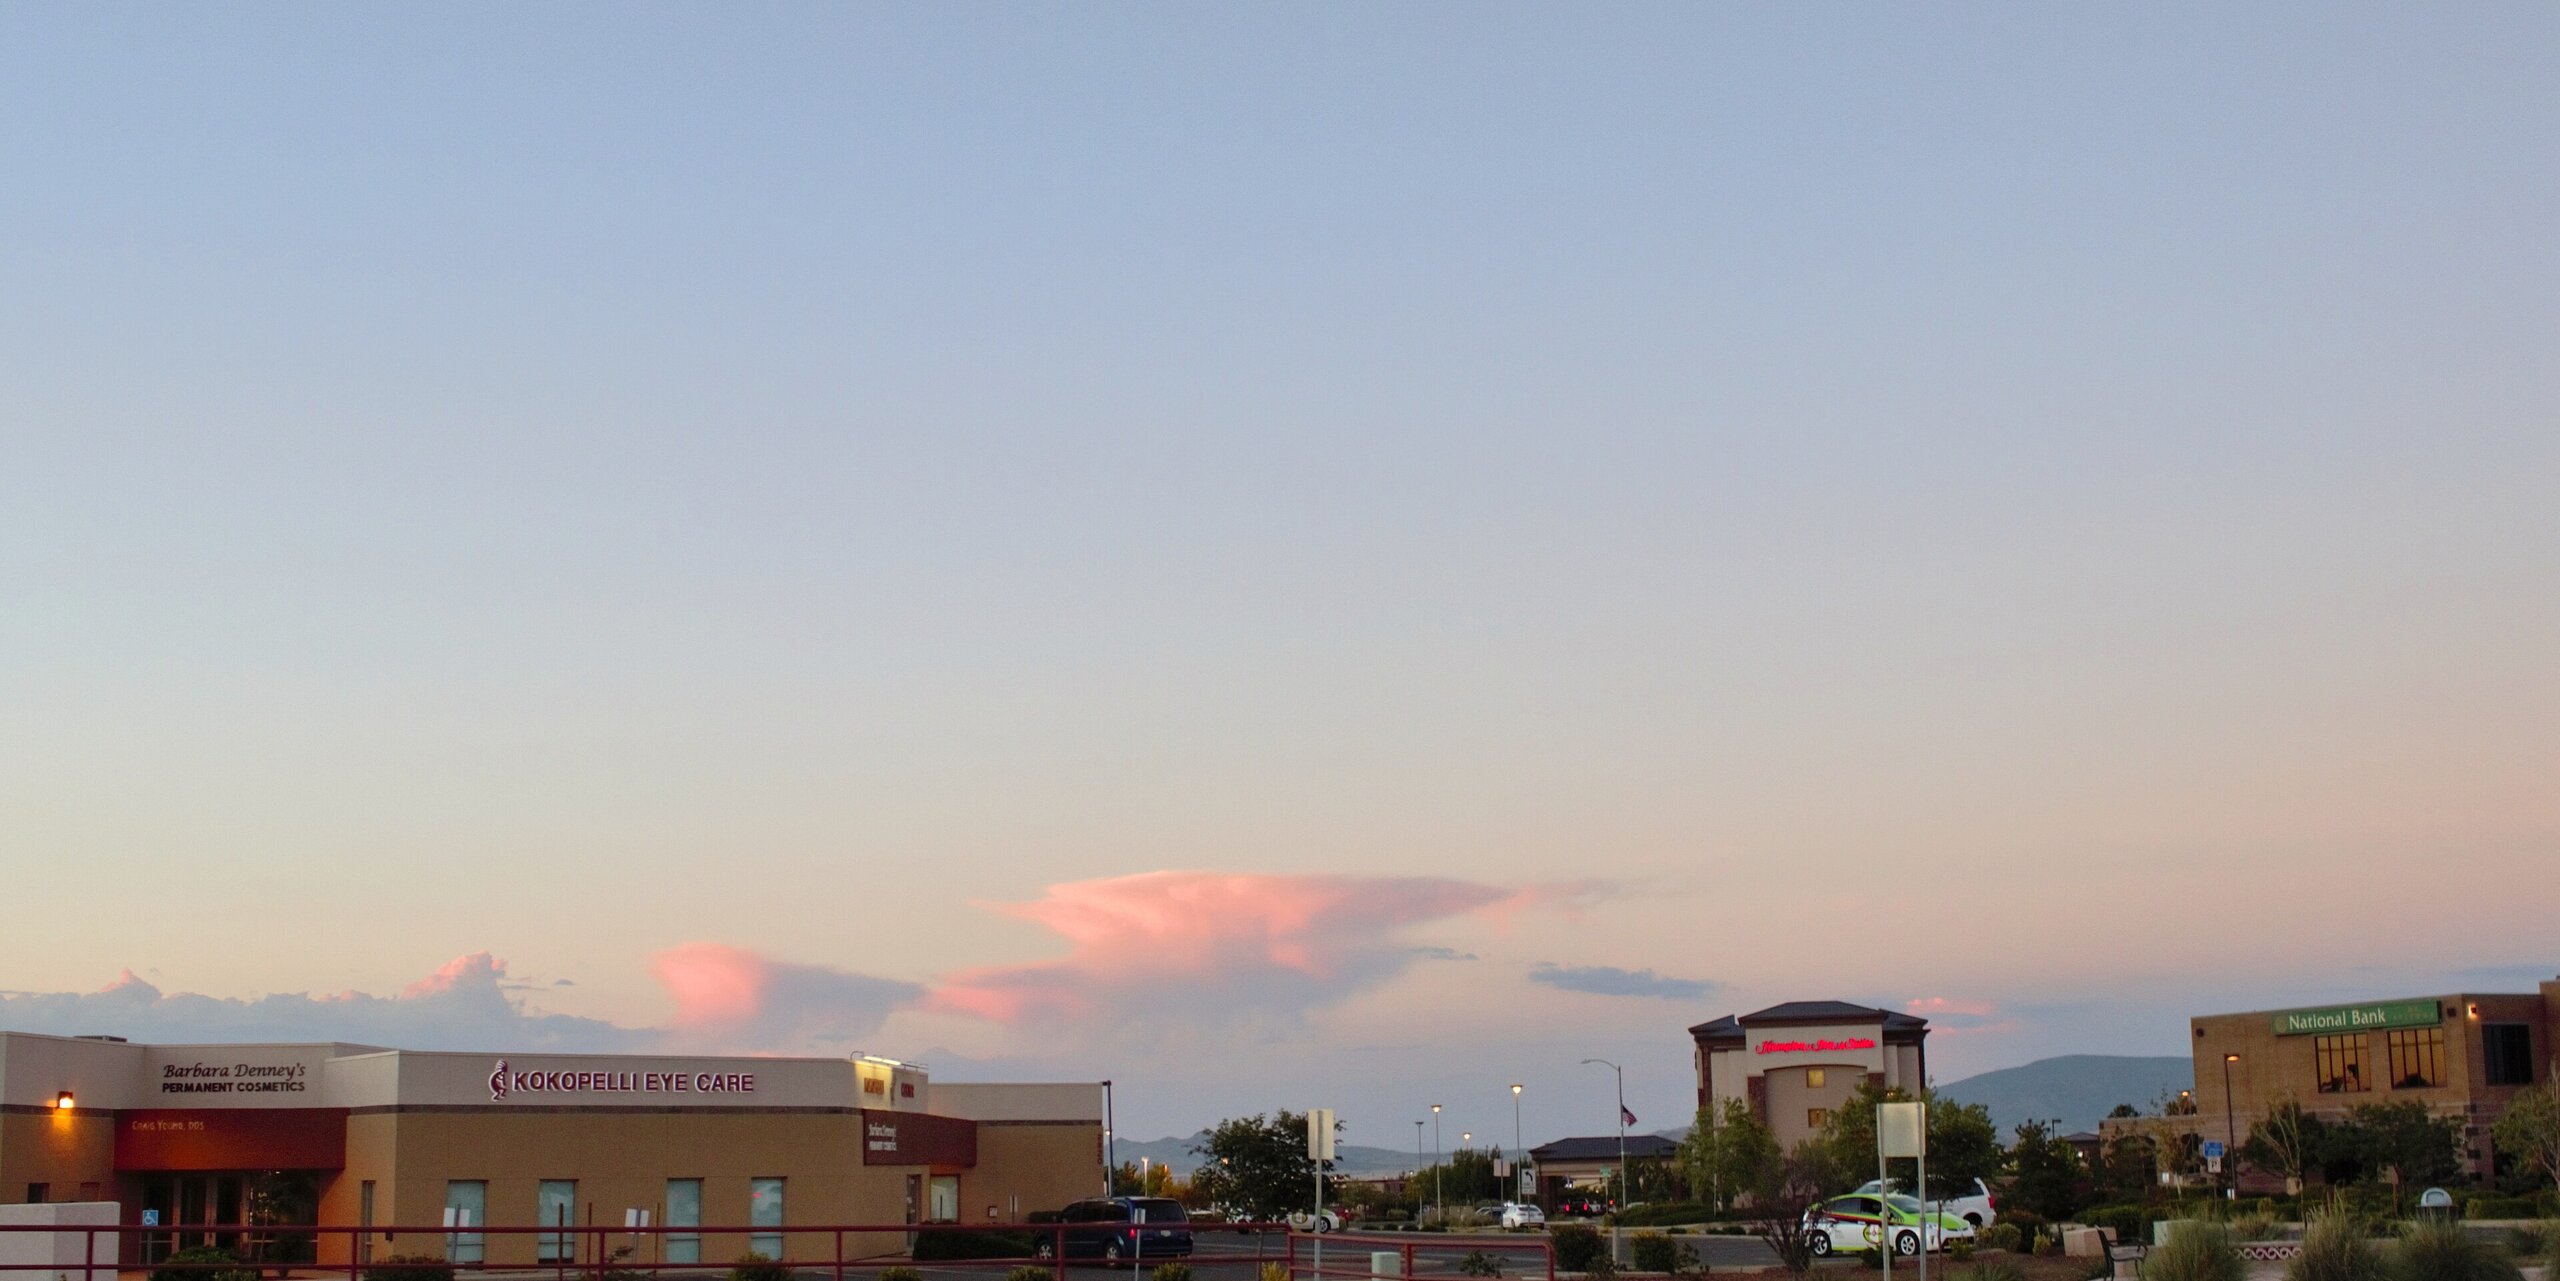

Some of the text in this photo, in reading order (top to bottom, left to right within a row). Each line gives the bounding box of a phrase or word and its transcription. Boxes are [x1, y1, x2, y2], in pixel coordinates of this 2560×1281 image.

[2289, 1011, 2346, 1030] National
[2351, 1008, 2386, 1025] Bank
[163, 1062, 306, 1082] Barbara Denney's
[512, 1071, 754, 1093] KOKOPELLI EYE CARE
[162, 1081, 305, 1093] PERMANENT COSMETICS
